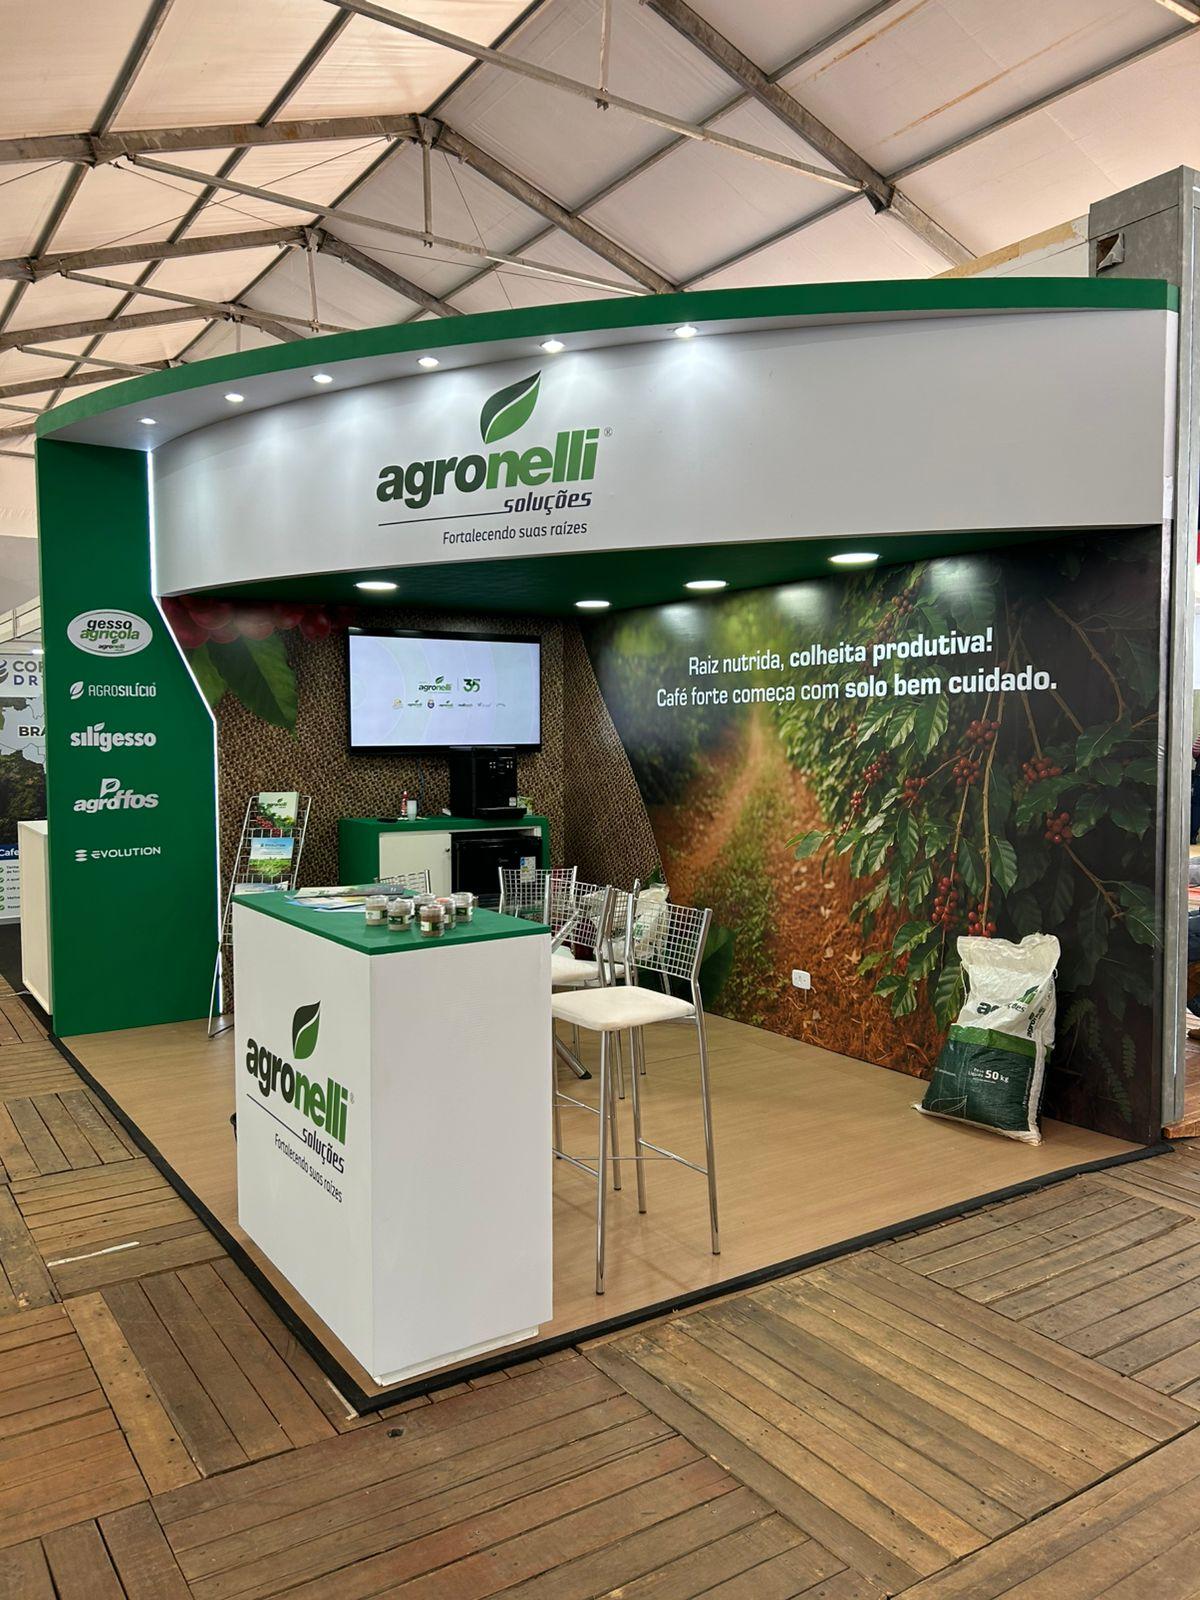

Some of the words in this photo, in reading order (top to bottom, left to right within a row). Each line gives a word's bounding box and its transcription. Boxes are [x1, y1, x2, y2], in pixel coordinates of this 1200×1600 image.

[376, 428, 600, 509] agronelli
[503, 489, 593, 515] soluções
[442, 525, 516, 545] Fortalecendo
[518, 524, 547, 539] suas
[549, 521, 588, 536] raízes
[87, 619, 133, 631] gesso
[688, 655, 719, 676] Raiz
[722, 649, 785, 673] nutrida,
[789, 641, 867, 668] colheita
[872, 626, 994, 667] produtiva!
[88, 682, 157, 697] AGROSILÍCIO
[657, 685, 688, 707] Café
[691, 686, 728, 705] forte
[732, 685, 796, 706] começa
[800, 682, 839, 700] com
[844, 675, 888, 698] solo
[894, 673, 941, 696] bem
[949, 665, 1058, 694] cuidado.
[91, 847, 161, 859] EVOLUTION
[246, 1038, 349, 1146] agronelli
[984, 1069, 1000, 1081] 50
[301, 1127, 345, 1174] soluções
[274, 1133, 309, 1174] Fortalecendo
[309, 1165, 324, 1186] suas
[323, 1178, 343, 1203] raízes
